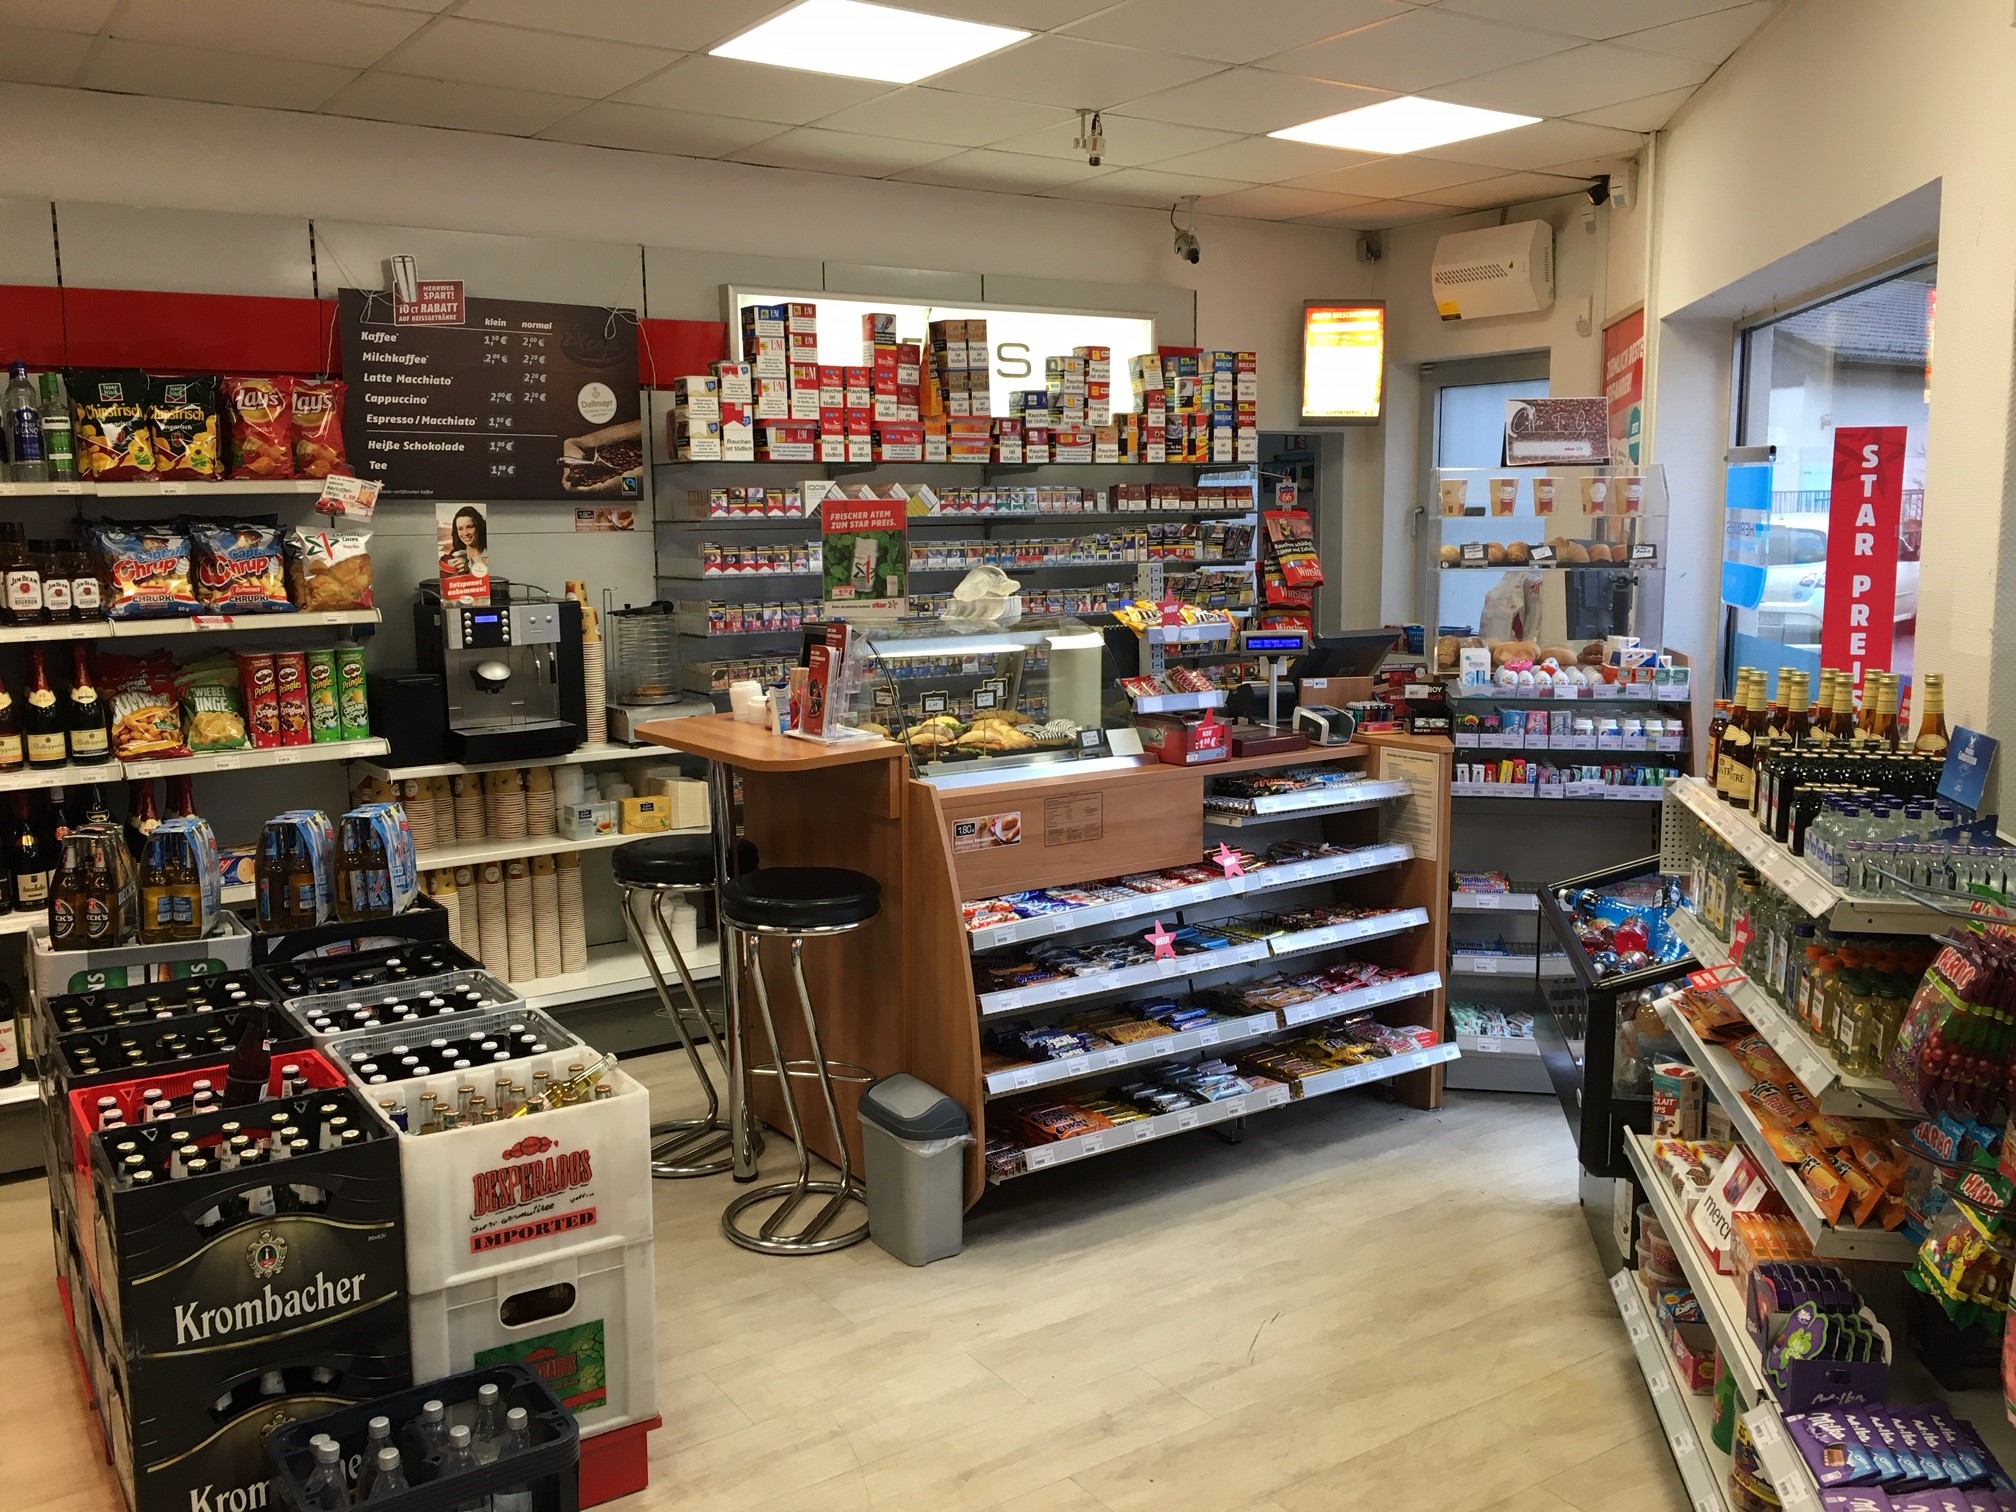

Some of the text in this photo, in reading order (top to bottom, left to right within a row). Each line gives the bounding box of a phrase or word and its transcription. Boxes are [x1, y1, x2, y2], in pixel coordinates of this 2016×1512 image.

[423, 291, 455, 300] SPART!
[400, 304, 410, 314] 10
[421, 303, 458, 313] RABATT
[412, 314, 457, 322] HEISSGETRÄNKE
[485, 318, 552, 330] klein normal
[364, 373, 393, 383] Latte
[236, 391, 279, 411] Lay's
[292, 391, 332, 413] Lay's
[581, 400, 613, 409] Dallmayr
[86, 403, 142, 421] Chipsfrisch
[368, 440, 400, 451] Heiße
[403, 441, 465, 452] Schokolade
[369, 460, 388, 470] Tee
[1282, 493, 1292, 501] 66
[1854, 445, 1879, 556] STAR
[830, 510, 890, 521] FRISCHER ATEM
[831, 519, 897, 529] ZUM STAR PREIS.
[113, 558, 177, 588] Chrup
[214, 555, 269, 588] Chrup
[10, 575, 37, 586] JIM BEAM
[449, 579, 483, 588] Entspannt
[447, 586, 487, 596] ankommen!
[1280, 586, 1312, 600] Winston
[229, 594, 269, 603] CHRUPKI
[1164, 605, 1178, 613] NEU!
[280, 681, 302, 696] Pringles
[311, 678, 333, 693] Pringles
[343, 677, 364, 691] Pringles
[1202, 729, 1212, 737] NUR
[1223, 857, 1236, 866] NEU!
[1156, 937, 1170, 946] NEU!
[1937, 946, 1976, 990] HARIBO
[1056, 1119, 1087, 1135] CORNY
[1915, 1121, 1952, 1160] HARIBO
[472, 1150, 593, 1216] DESPERADOS
[1703, 1195, 1732, 1240] merci
[474, 1212, 594, 1250] IMPORTED
[174, 1271, 366, 1345] Krombacher
[1808, 1412, 1846, 1440] Milka
[1846, 1414, 1871, 1441] Milka
[1870, 1416, 1895, 1444] Milka
[1892, 1418, 1917, 1446] Milka
[1912, 1419, 1939, 1447] Milka
[1929, 1414, 1956, 1442] Milka
